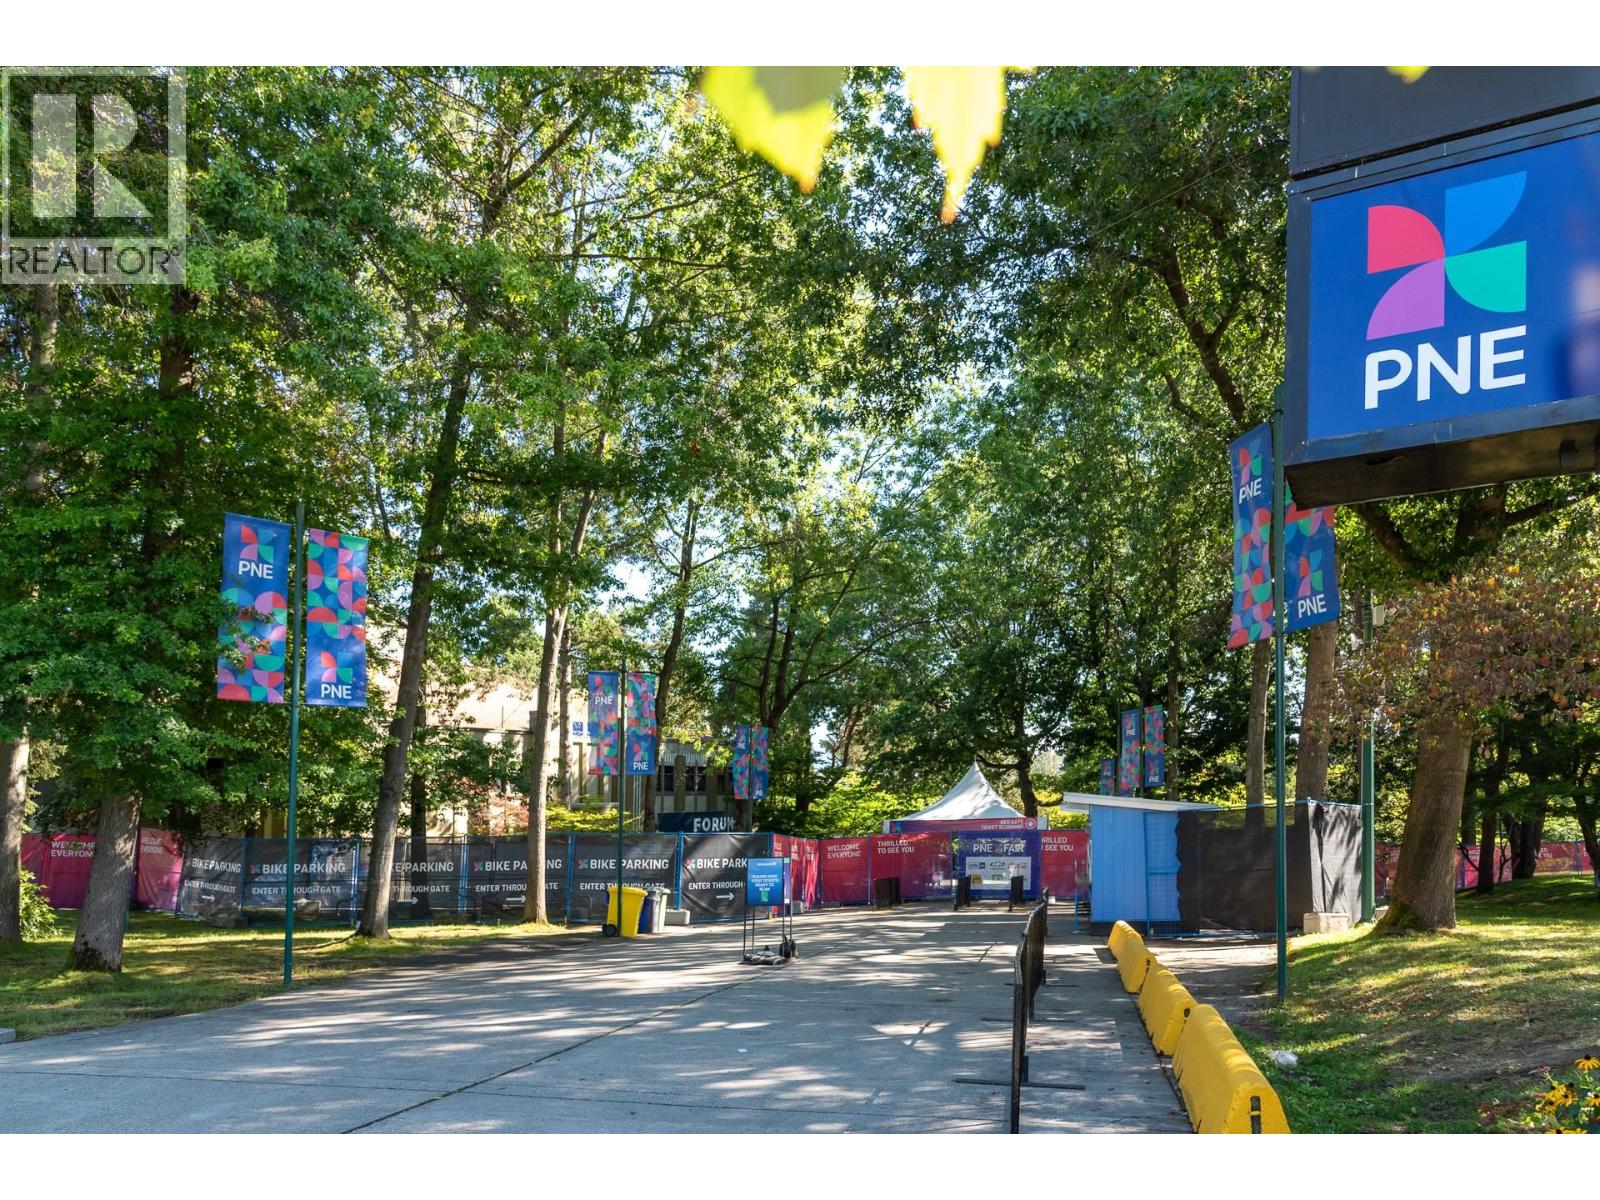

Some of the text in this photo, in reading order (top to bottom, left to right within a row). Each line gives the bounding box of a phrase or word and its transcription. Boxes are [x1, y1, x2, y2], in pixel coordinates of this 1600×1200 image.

[1364, 324, 1527, 410] PNE
[1238, 478, 1262, 504] PNE
[238, 560, 274, 580] PNE
[1298, 593, 1327, 618] PNE
[320, 683, 352, 699] PNE
[594, 695, 613, 705] PNE
[633, 761, 649, 771] PNE
[827, 843, 860, 852] WELCOME
[877, 840, 908, 848] THRILLED
[887, 846, 900, 854] SEE
[901, 845, 915, 854] YOU
[973, 843, 1025, 853] PNE FAIR
[1059, 844, 1074, 852] YOU
[50, 849, 95, 858] EVERYON
[827, 850, 861, 859] EVERYONE
[192, 857, 242, 873] BIKE PARKING
[262, 862, 346, 875] BIKE PARKING
[404, 861, 455, 873] PARKING
[484, 860, 511, 872] BIKE
[589, 859, 670, 870] BIKE PARKING
[696, 858, 721, 870] BIKE
[722, 857, 748, 869] PARK
[430, 884, 451, 893] GATE
[475, 882, 560, 893] ENTER THROU ATE
[579, 882, 606, 891] ENTER
[688, 880, 744, 891] ENTER THROUGH
[251, 887, 279, 896] ENTER
